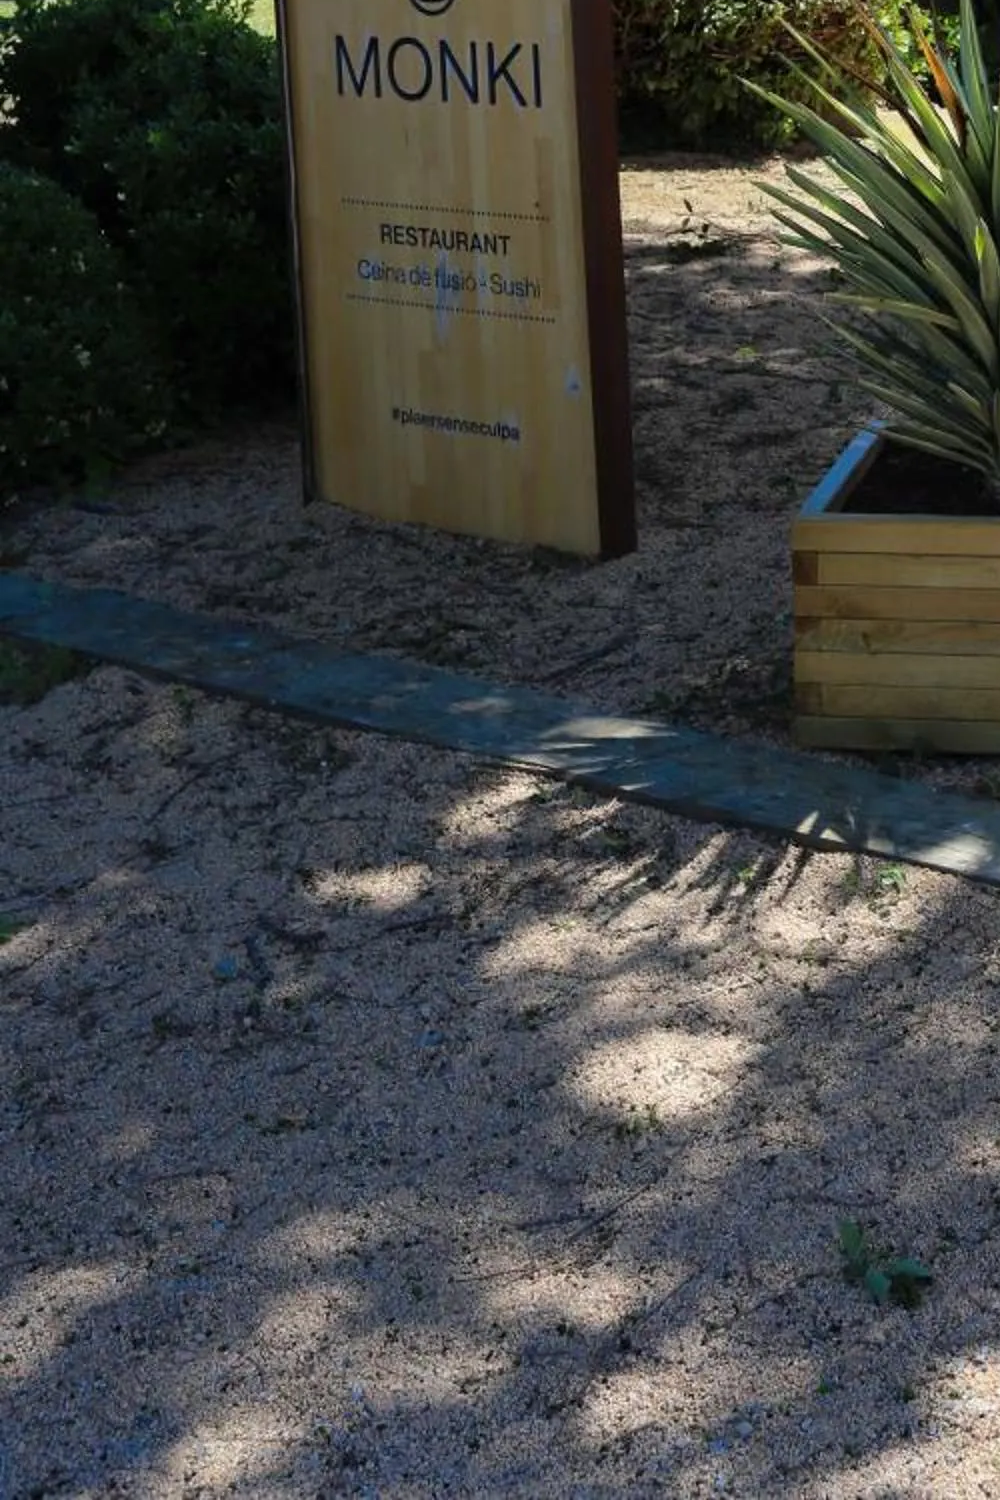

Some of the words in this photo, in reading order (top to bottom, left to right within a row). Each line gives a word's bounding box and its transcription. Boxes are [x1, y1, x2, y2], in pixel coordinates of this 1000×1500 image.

[335, 35, 542, 108] MONKI
[380, 224, 511, 255] RESTAURANT
[410, 266, 431, 287] de
[489, 273, 541, 298] Sushi
